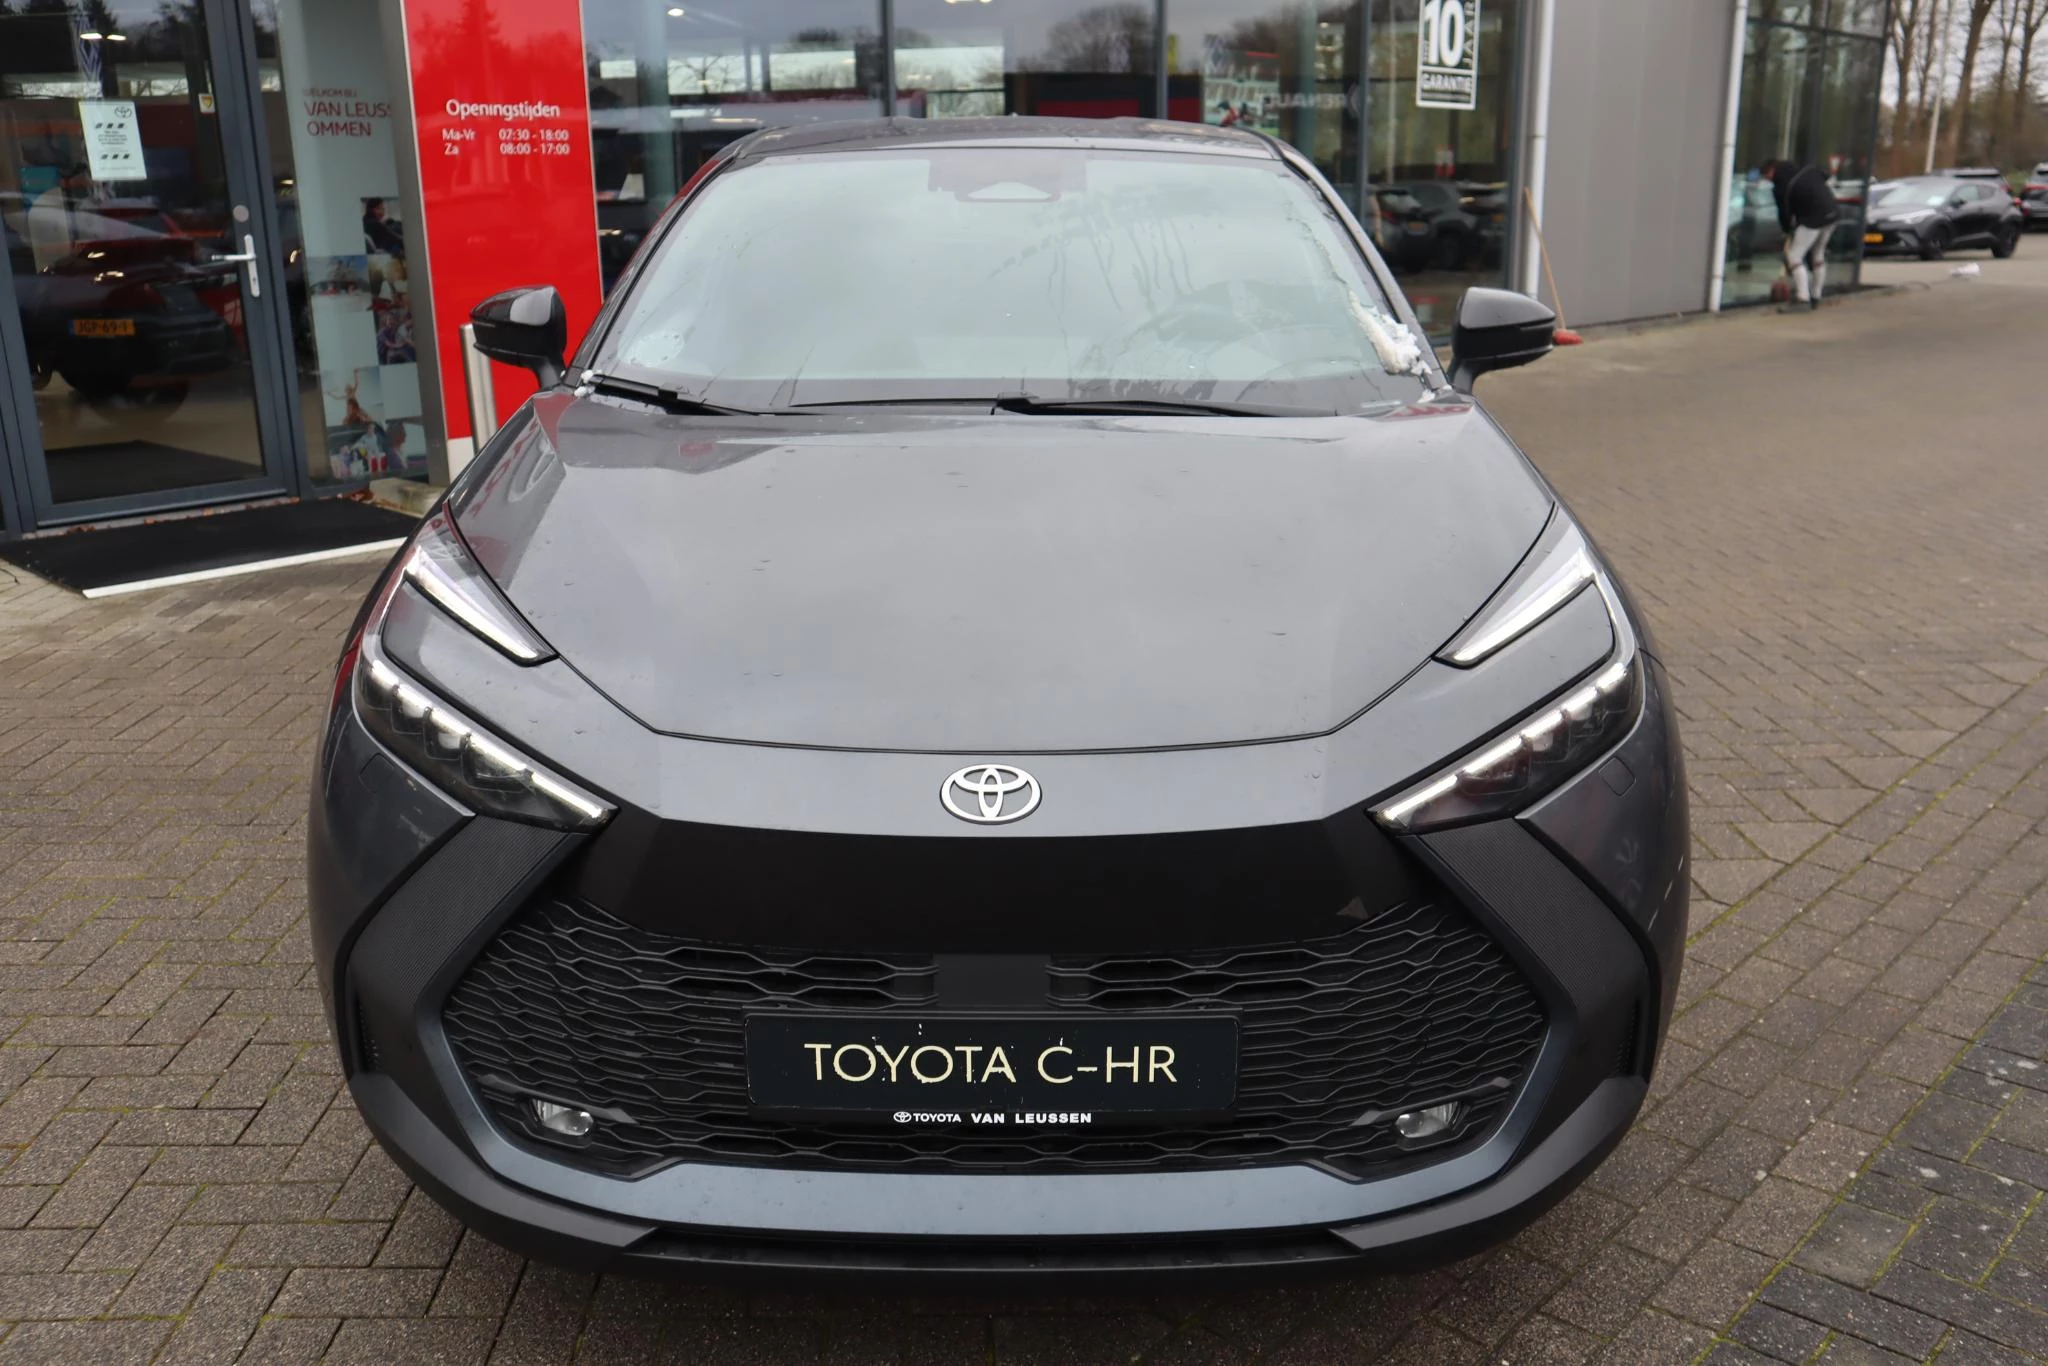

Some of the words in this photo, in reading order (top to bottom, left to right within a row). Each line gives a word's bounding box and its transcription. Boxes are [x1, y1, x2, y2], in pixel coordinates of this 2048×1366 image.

[1424, 0, 1465, 67] 10
[304, 101, 341, 117] VAN
[446, 98, 560, 120] Openingstijden
[307, 121, 371, 136] OMMEN
[442, 128, 476, 140] Ma-Vr
[498, 128, 530, 140] 07:30
[540, 129, 569, 140] 18:00
[444, 142, 459, 155] Za
[500, 143, 530, 155] 08:00
[541, 143, 570, 155] 17:00
[804, 1043, 1017, 1083] TOYOTA
[1038, 1046, 1177, 1083] C-HR
[913, 1113, 961, 1122] TOYOTA
[971, 1113, 1004, 1123] VAN
[1016, 1113, 1091, 1123] LEUSSEN
